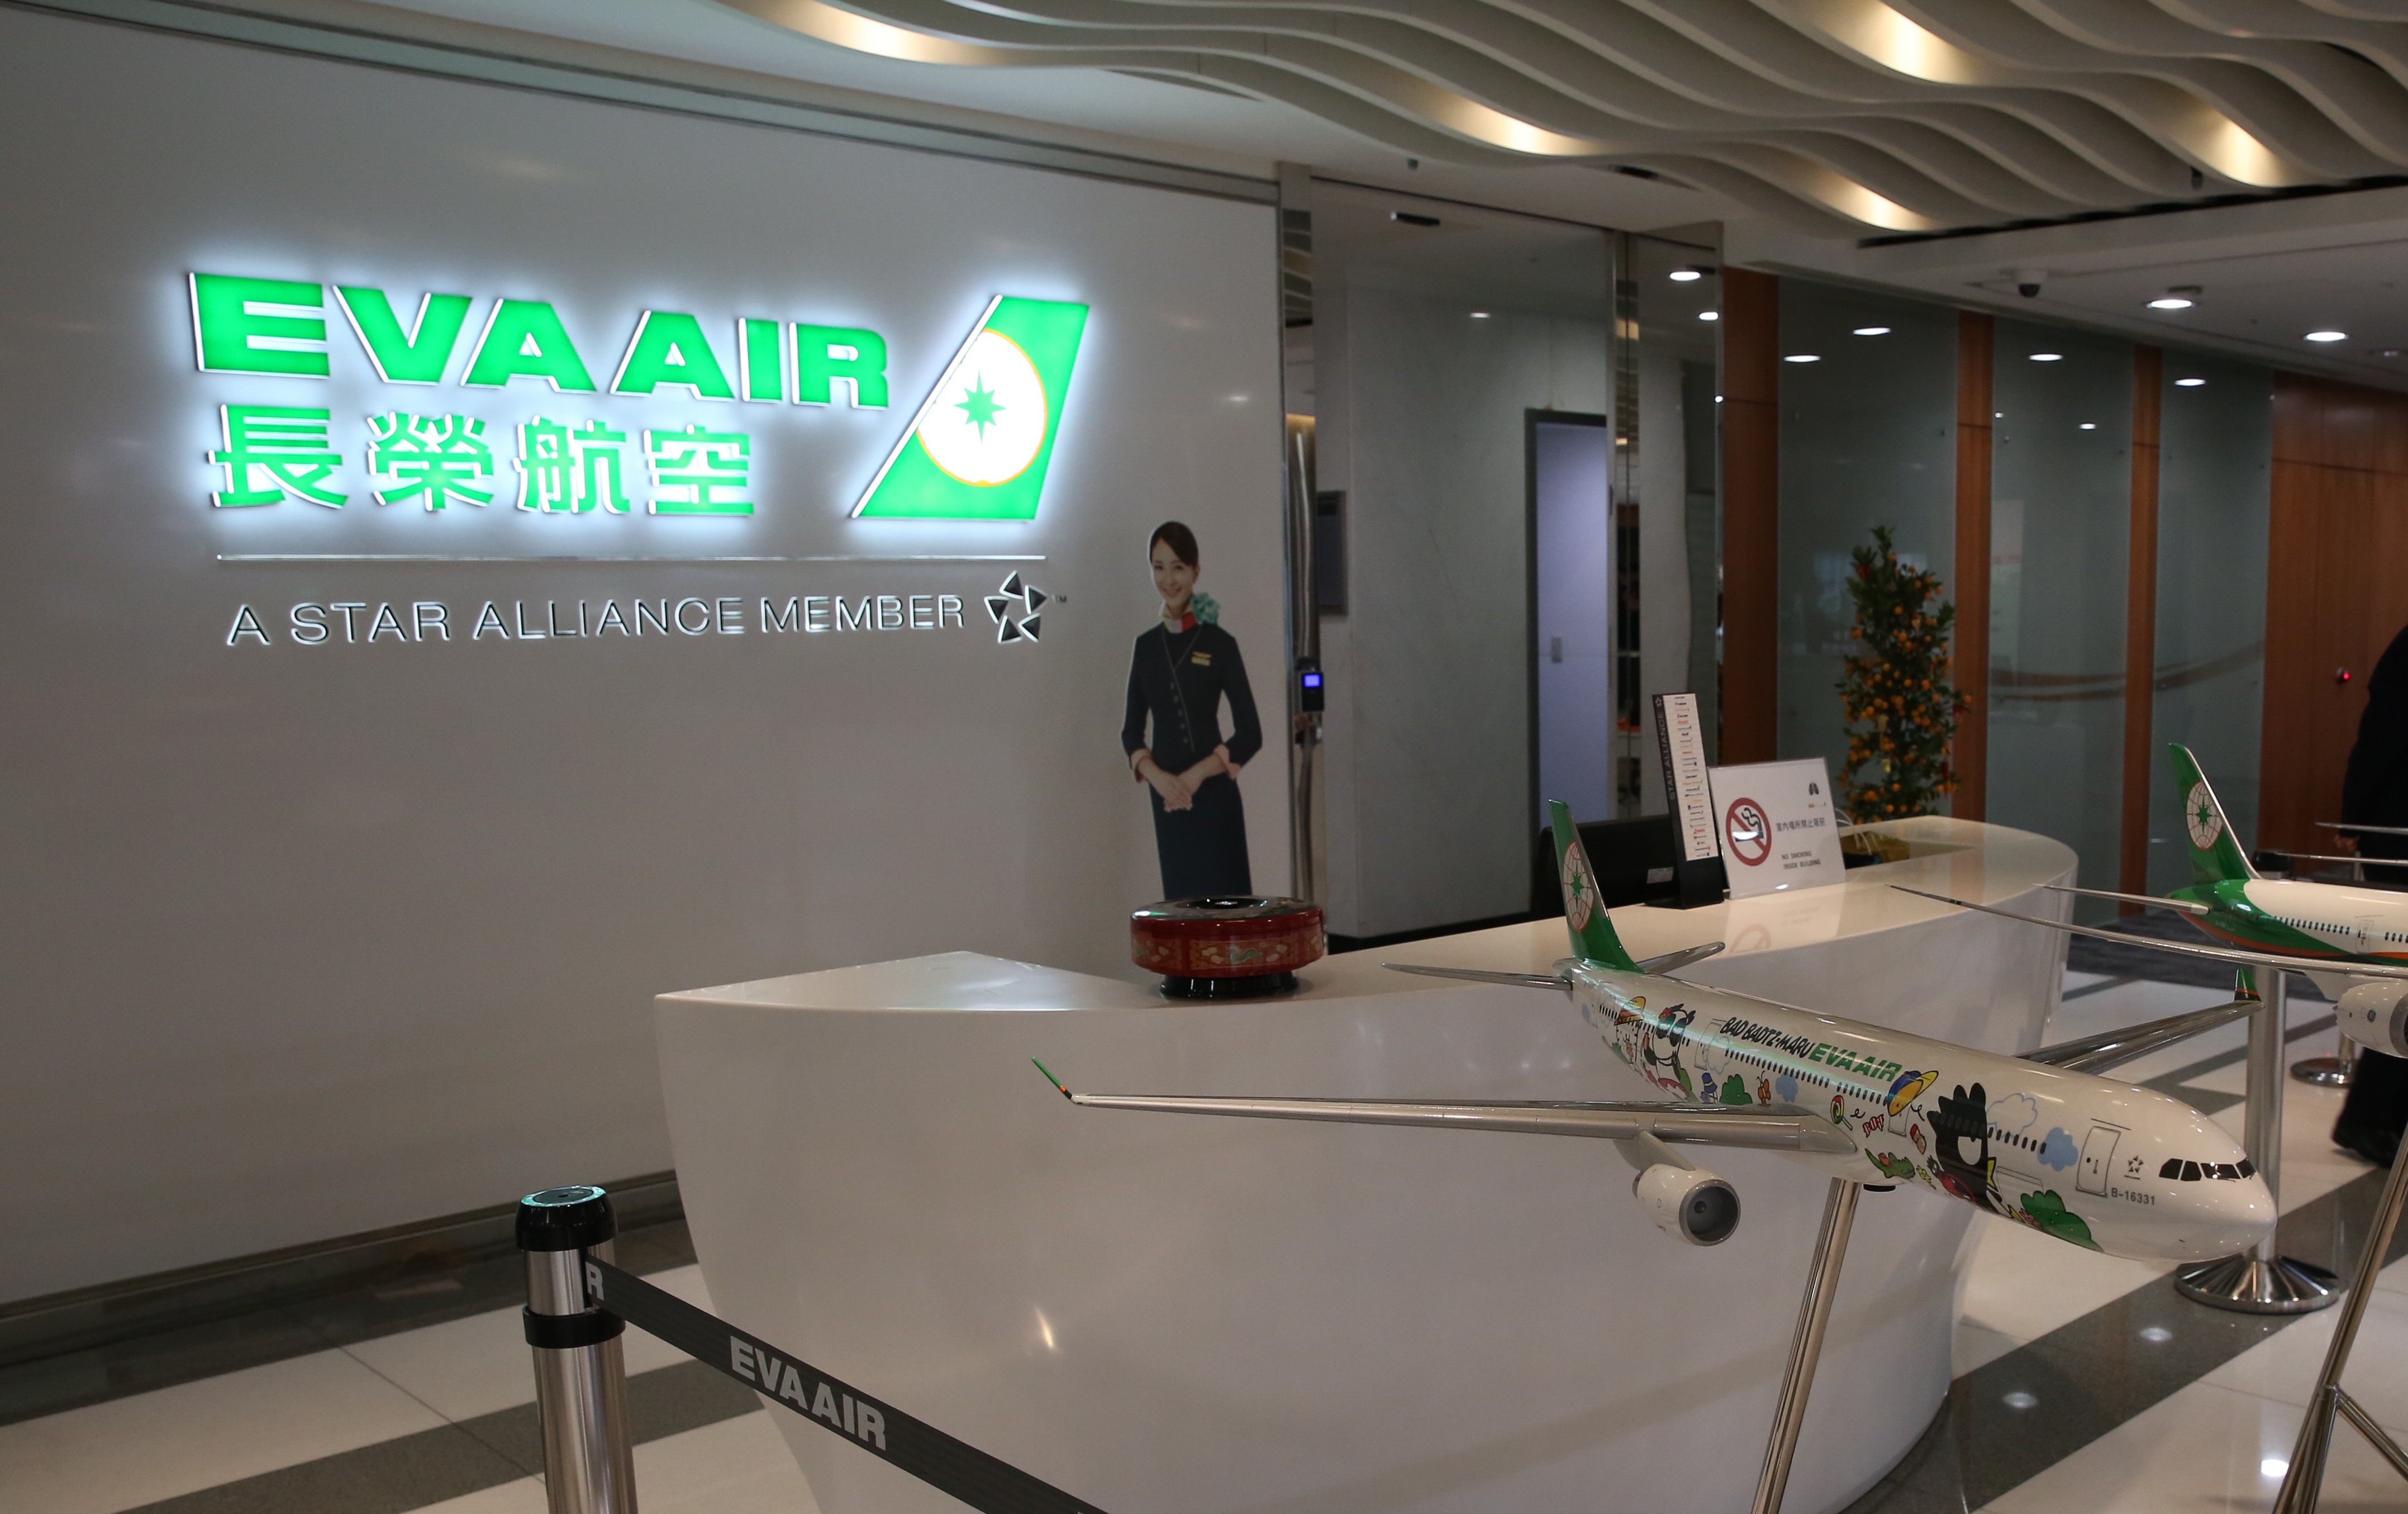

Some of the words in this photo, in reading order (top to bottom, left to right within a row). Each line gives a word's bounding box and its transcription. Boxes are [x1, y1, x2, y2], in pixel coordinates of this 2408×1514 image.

[208, 404, 755, 514] 長榮航空
[226, 603, 271, 646] A
[290, 601, 450, 645] STAR
[473, 596, 745, 641] ALLIANCE
[760, 594, 964, 634] MEMBER
[1720, 1017, 1749, 1037] BAD
[2111, 1187, 2155, 1205] B-16331
